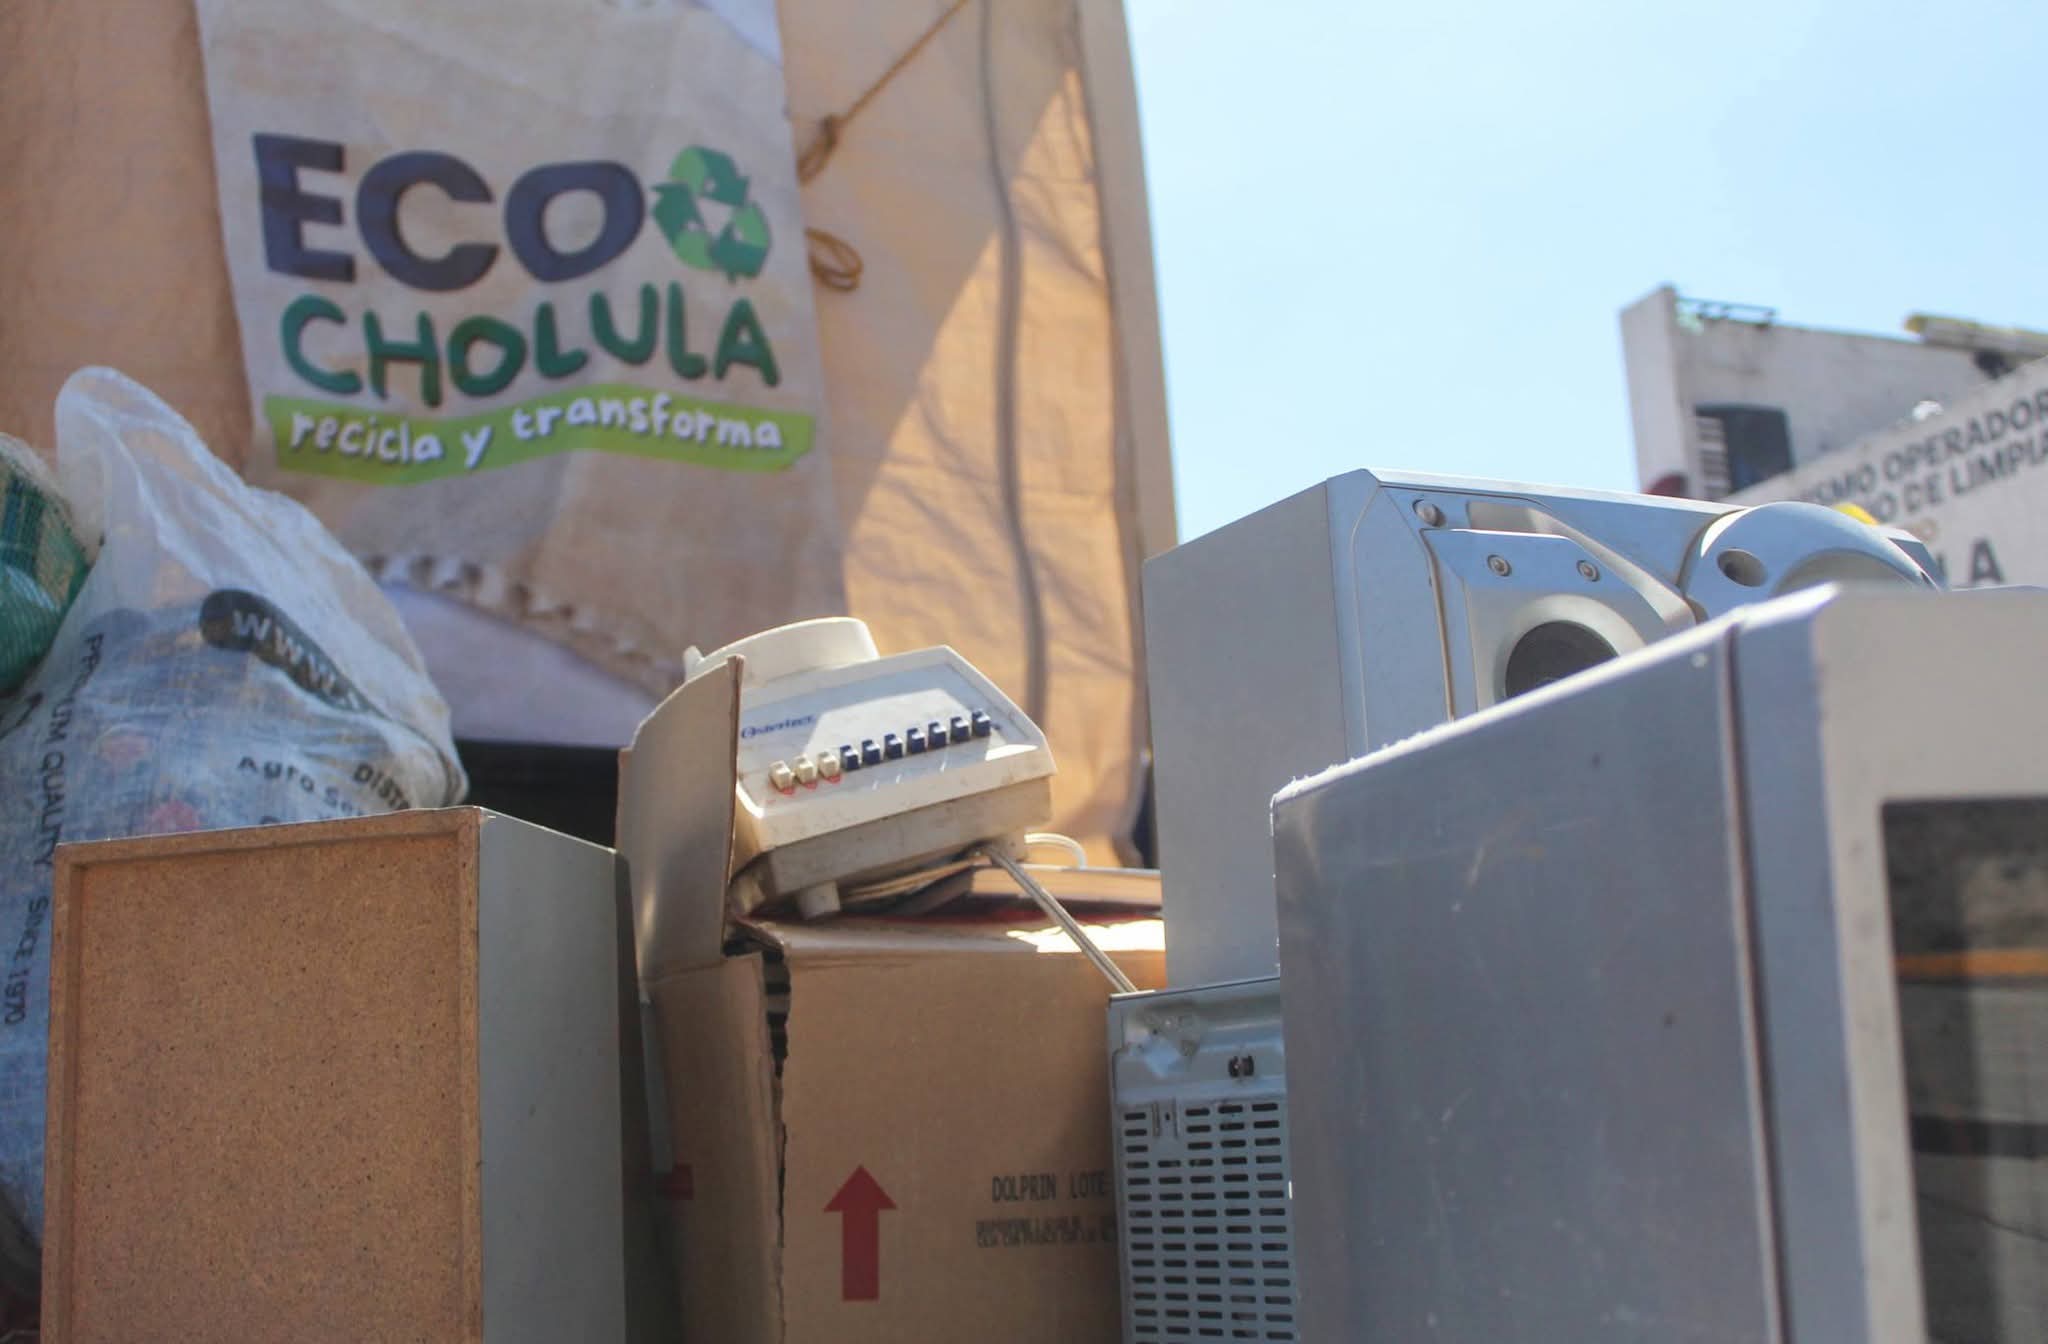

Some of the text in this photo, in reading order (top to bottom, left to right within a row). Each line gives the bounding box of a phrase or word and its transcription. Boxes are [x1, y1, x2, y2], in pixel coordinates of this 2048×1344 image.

[252, 132, 646, 291] ECO
[280, 282, 780, 408] CHOLULA
[289, 394, 783, 468] recicla y transforma
